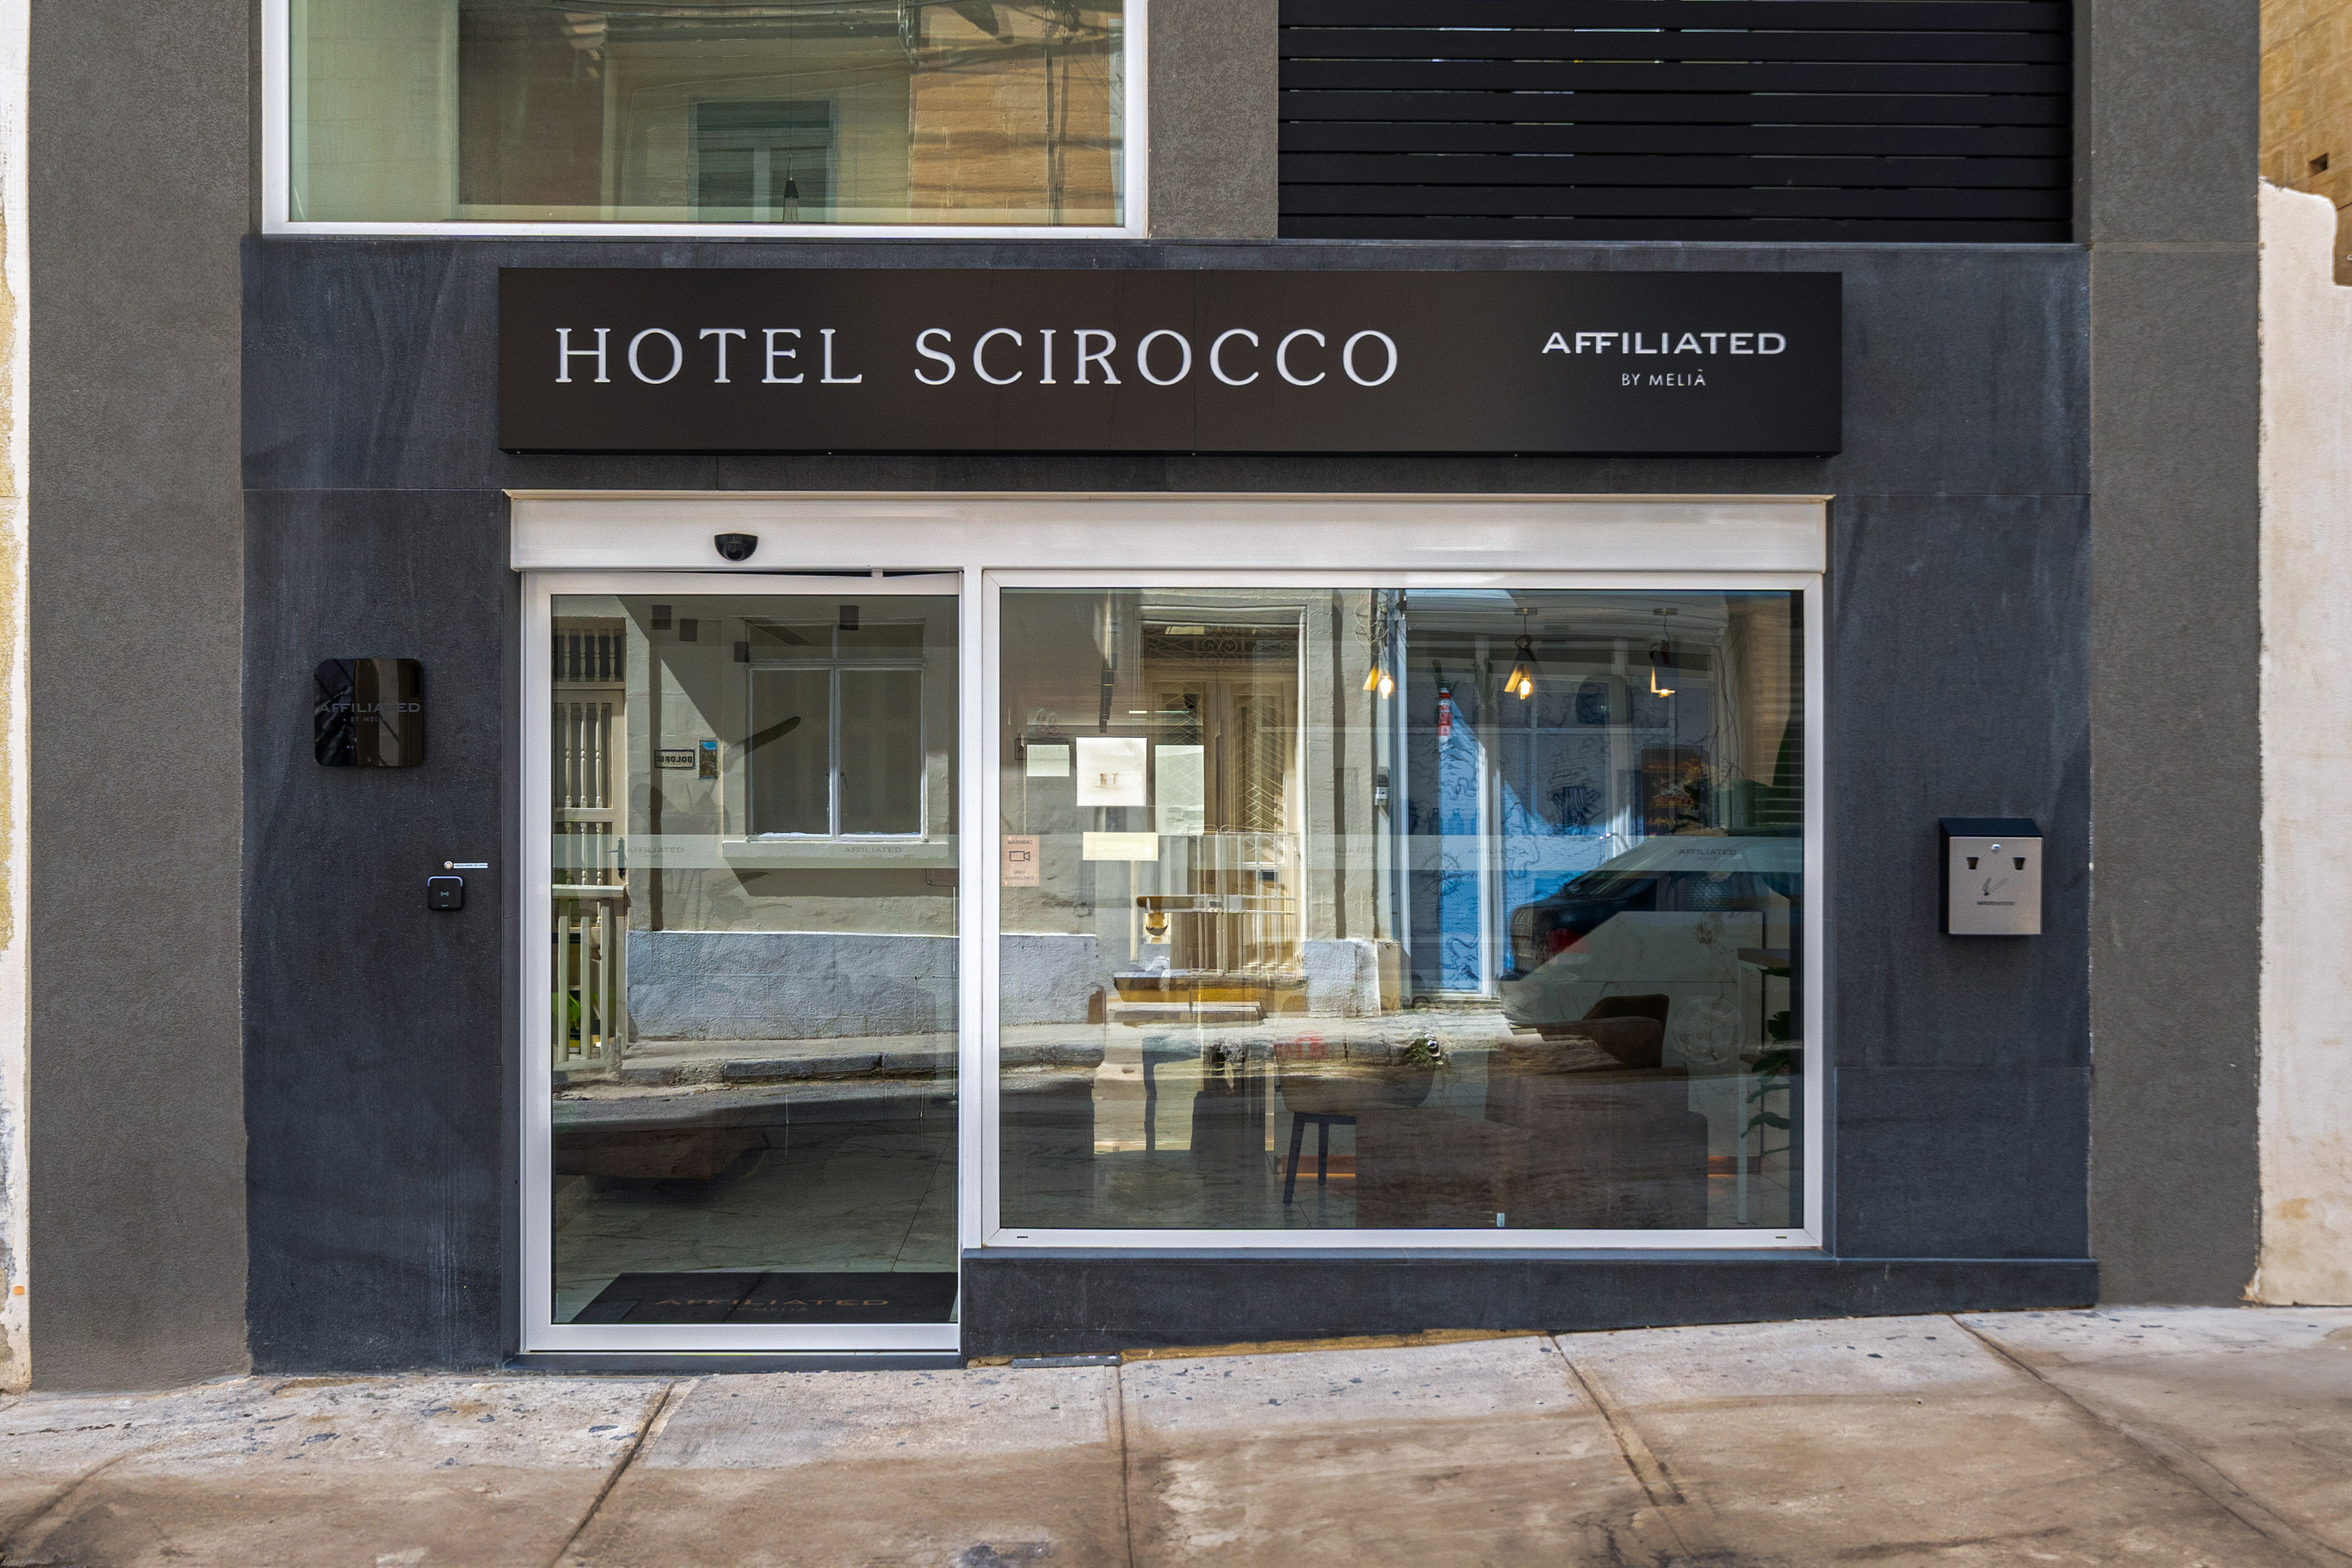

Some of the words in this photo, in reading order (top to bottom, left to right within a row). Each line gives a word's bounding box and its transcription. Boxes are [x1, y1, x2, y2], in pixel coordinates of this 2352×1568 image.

[1541, 331, 1786, 354] AFFILIATED
[555, 327, 863, 385] HOTEL
[913, 327, 1399, 386] SCIROCCO
[1621, 372, 1640, 386] BY
[1649, 368, 1706, 386] MELIÀ
[319, 703, 421, 713] AFFILIAED
